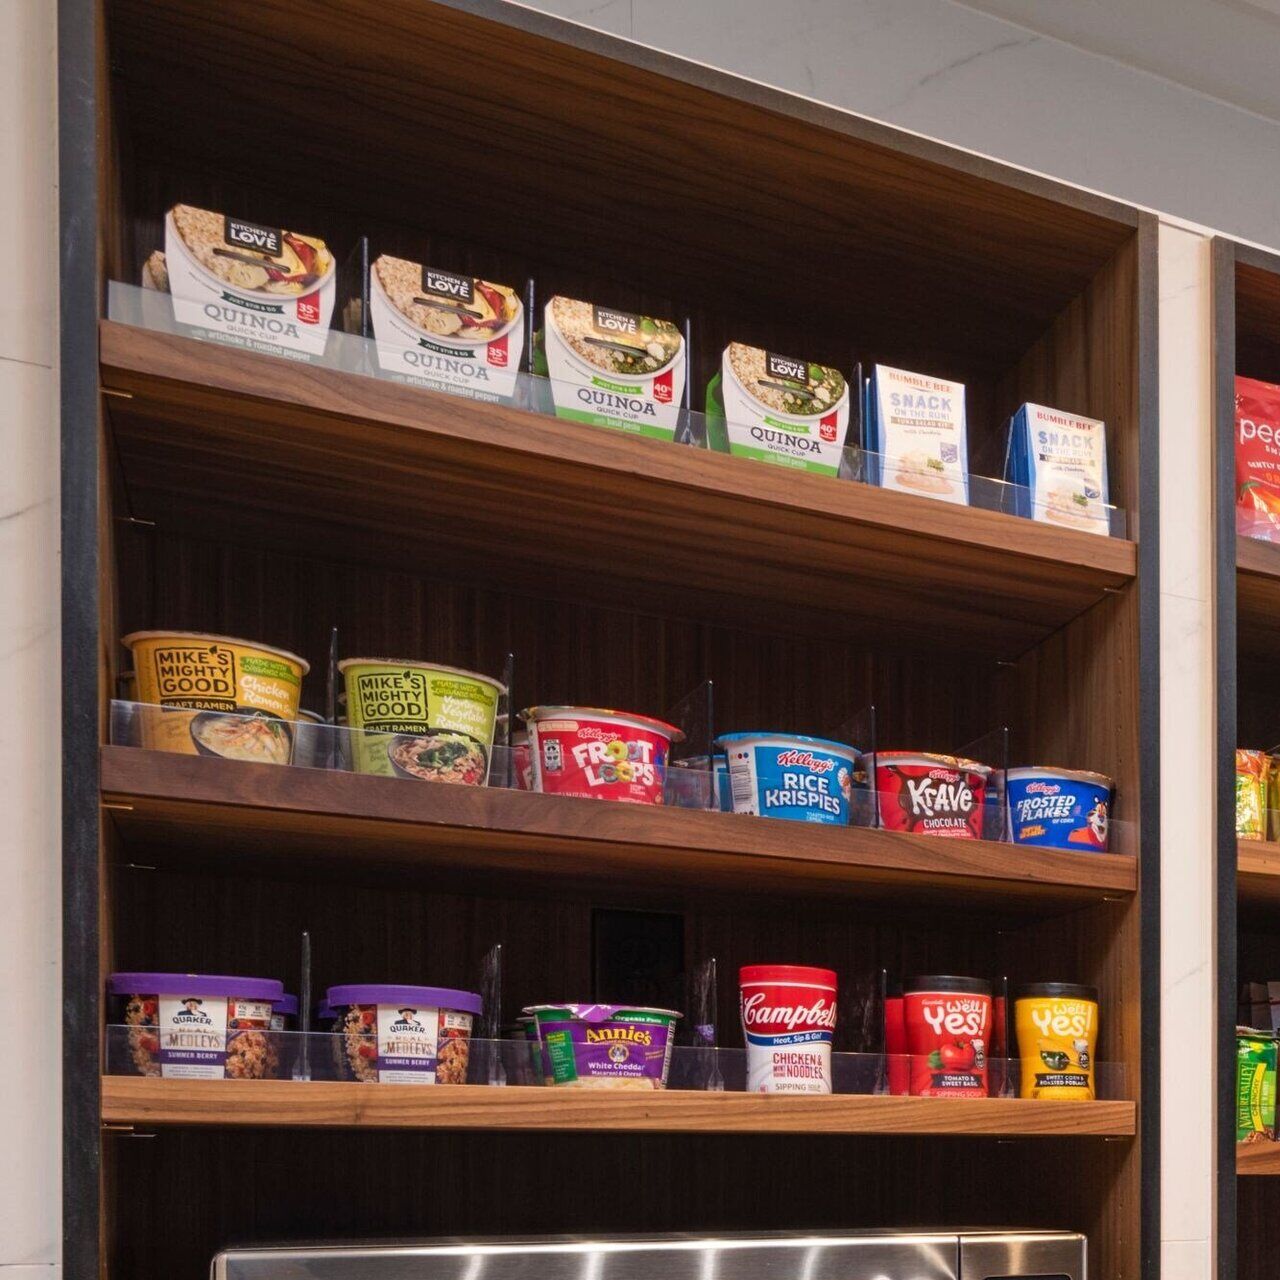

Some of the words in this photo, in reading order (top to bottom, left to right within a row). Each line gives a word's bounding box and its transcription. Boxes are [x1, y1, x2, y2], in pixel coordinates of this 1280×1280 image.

[230, 229, 277, 250] LOVE
[427, 278, 470, 298] LOVE
[204, 303, 300, 338] QUINOA
[598, 317, 637, 335] LOVE
[403, 350, 490, 381] QUINOA
[770, 363, 806, 380] LOVE
[889, 372, 932, 390] BUMBLE
[933, 382, 952, 393] BEE
[577, 388, 657, 416] QUINOA
[890, 392, 952, 412] SNACK
[1037, 411, 1074, 428] BUMBLE
[1076, 422, 1094, 431] BEE
[750, 427, 822, 453] QUINOA
[1038, 431, 1094, 450] SNACK
[159, 650, 229, 666] MIKE'S
[160, 665, 230, 678] MIGHTY
[163, 678, 230, 693] GOOD
[361, 677, 421, 690] MIKE'S
[363, 691, 421, 702] MIGHTY
[195, 702, 234, 712] RAMEN
[365, 703, 422, 717] GOOD
[392, 725, 426, 733] RAMEN
[577, 727, 619, 742] Kellogg's
[778, 750, 835, 773] Kellogg's
[783, 773, 829, 794] RICE
[765, 789, 840, 815] KRISPIES
[1017, 795, 1076, 811] FROSTED
[1020, 807, 1071, 822] FLAKES
[923, 818, 967, 829] CHOCOLATE
[946, 999, 982, 1014] Well
[172, 1015, 212, 1025] QUAKER
[923, 1001, 987, 1036] Yes!
[1032, 1004, 1093, 1037] Yes!
[390, 1025, 425, 1033] QUAKER
[586, 1026, 652, 1045] Annie's
[168, 1051, 195, 1059] SUMMER
[773, 1052, 816, 1065] CHICKEN
[588, 1062, 612, 1070] White
[613, 1063, 645, 1071] Cheddar
[786, 1065, 824, 1079] NOODLES
[775, 1083, 806, 1091] SIPPING
